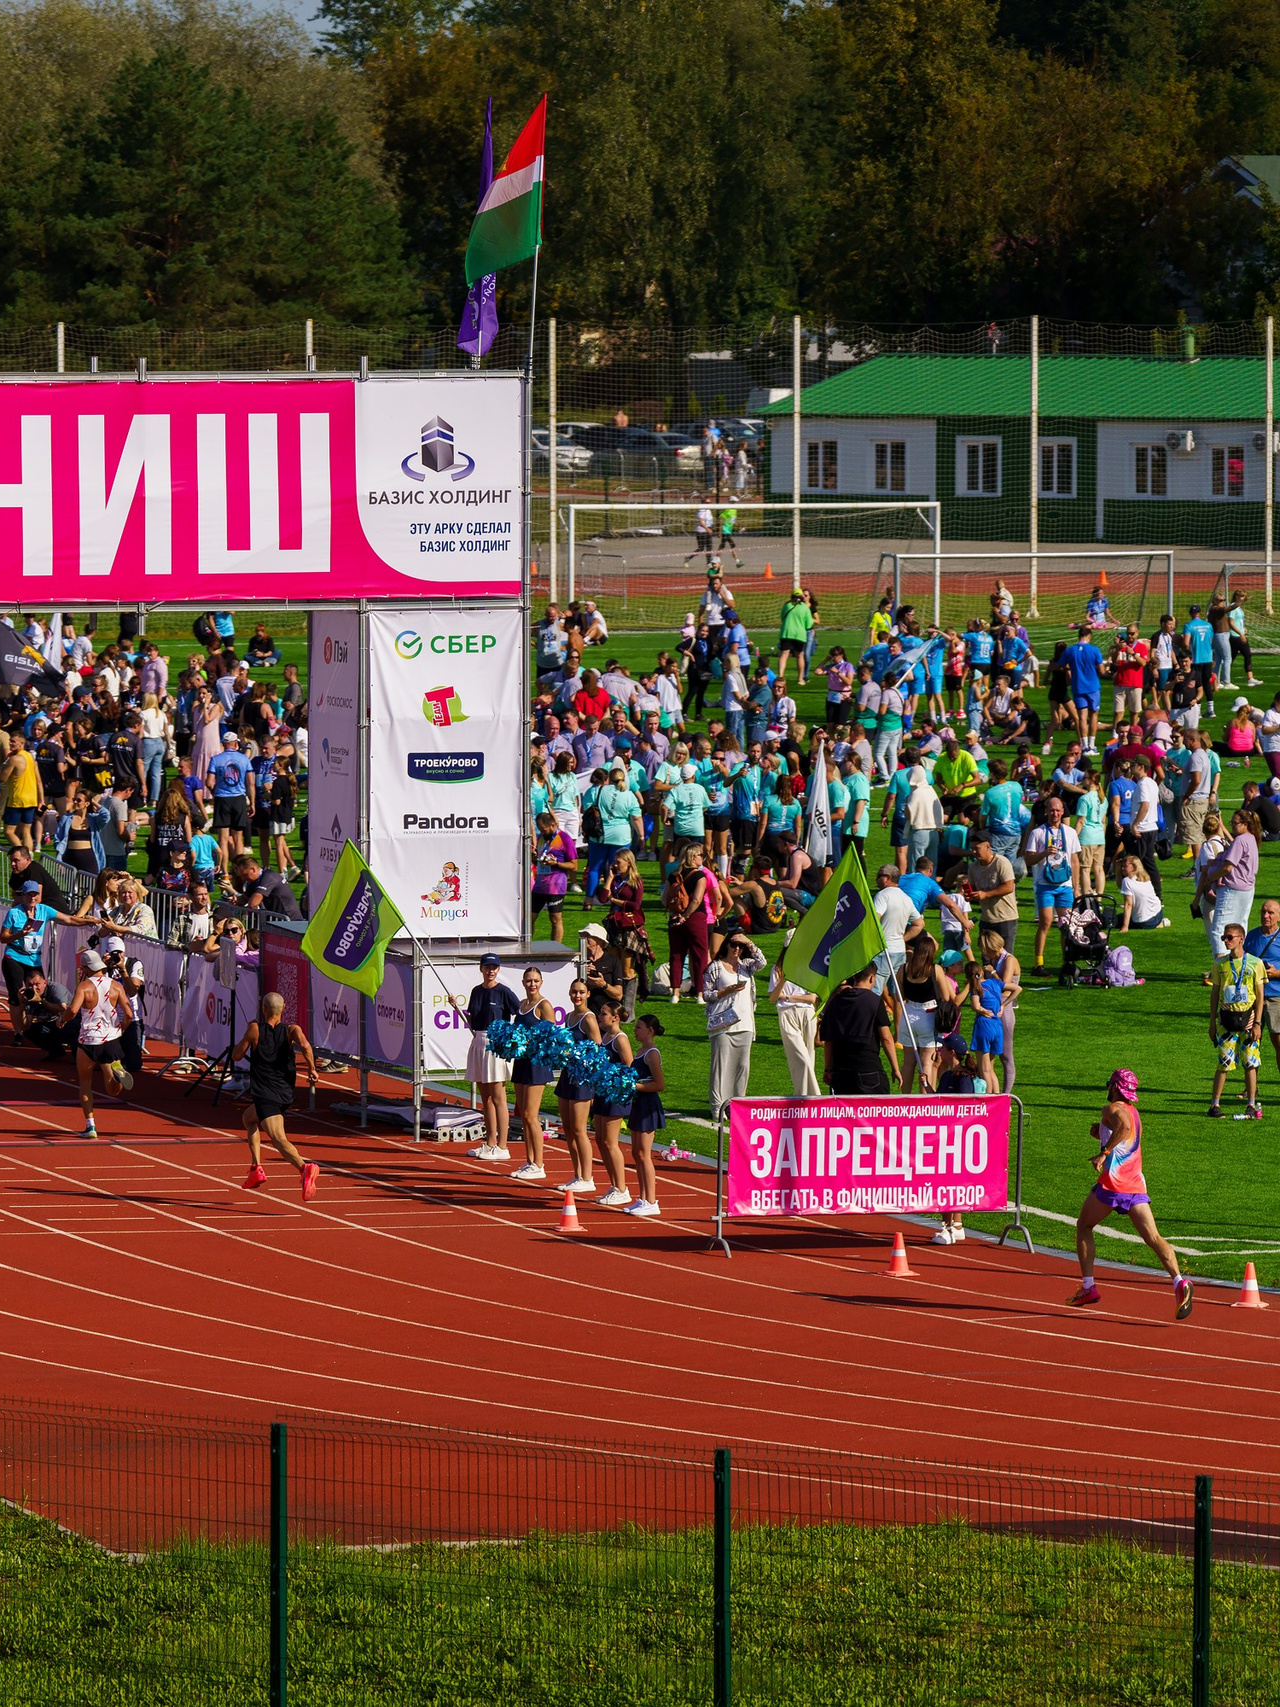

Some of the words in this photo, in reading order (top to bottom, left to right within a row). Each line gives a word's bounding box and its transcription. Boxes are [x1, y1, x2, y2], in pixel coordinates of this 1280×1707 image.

[368, 490, 424, 505] БАЗИС
[428, 489, 512, 507] ХОЛДИНГ
[410, 523, 430, 535] ЭТУ
[434, 523, 463, 535] АРКУ
[466, 521, 511, 536] СДЕЛАЛ
[420, 540, 456, 552] БАЗИС
[459, 539, 511, 554] ХОЛДИНГ
[333, 639, 348, 663] Пэй
[431, 635, 496, 654] СБЕР
[414, 758, 478, 768] ТРОЕКУРОВО
[403, 813, 489, 830] Pandora
[420, 906, 469, 921] Маруся
[377, 1003, 396, 1020] СПОРТ
[397, 1008, 405, 1022] 40
[750, 1106, 808, 1122] РОДИТЕЛЯМ
[810, 1106, 818, 1118] И
[820, 1106, 856, 1120] ЛИЦАМ,
[857, 1104, 955, 1120] СОПРОВОЖДАЮЩИМ
[956, 1102, 989, 1118] ДЕТЕЙ,
[750, 1124, 988, 1181] ЗАПРЕЩЕНО
[751, 1187, 818, 1210] ВБЕГАТЬ
[823, 1188, 833, 1209] В
[837, 1182, 933, 1208] ФИНИШНЫЙ
[936, 1184, 985, 1207] СТВОР
